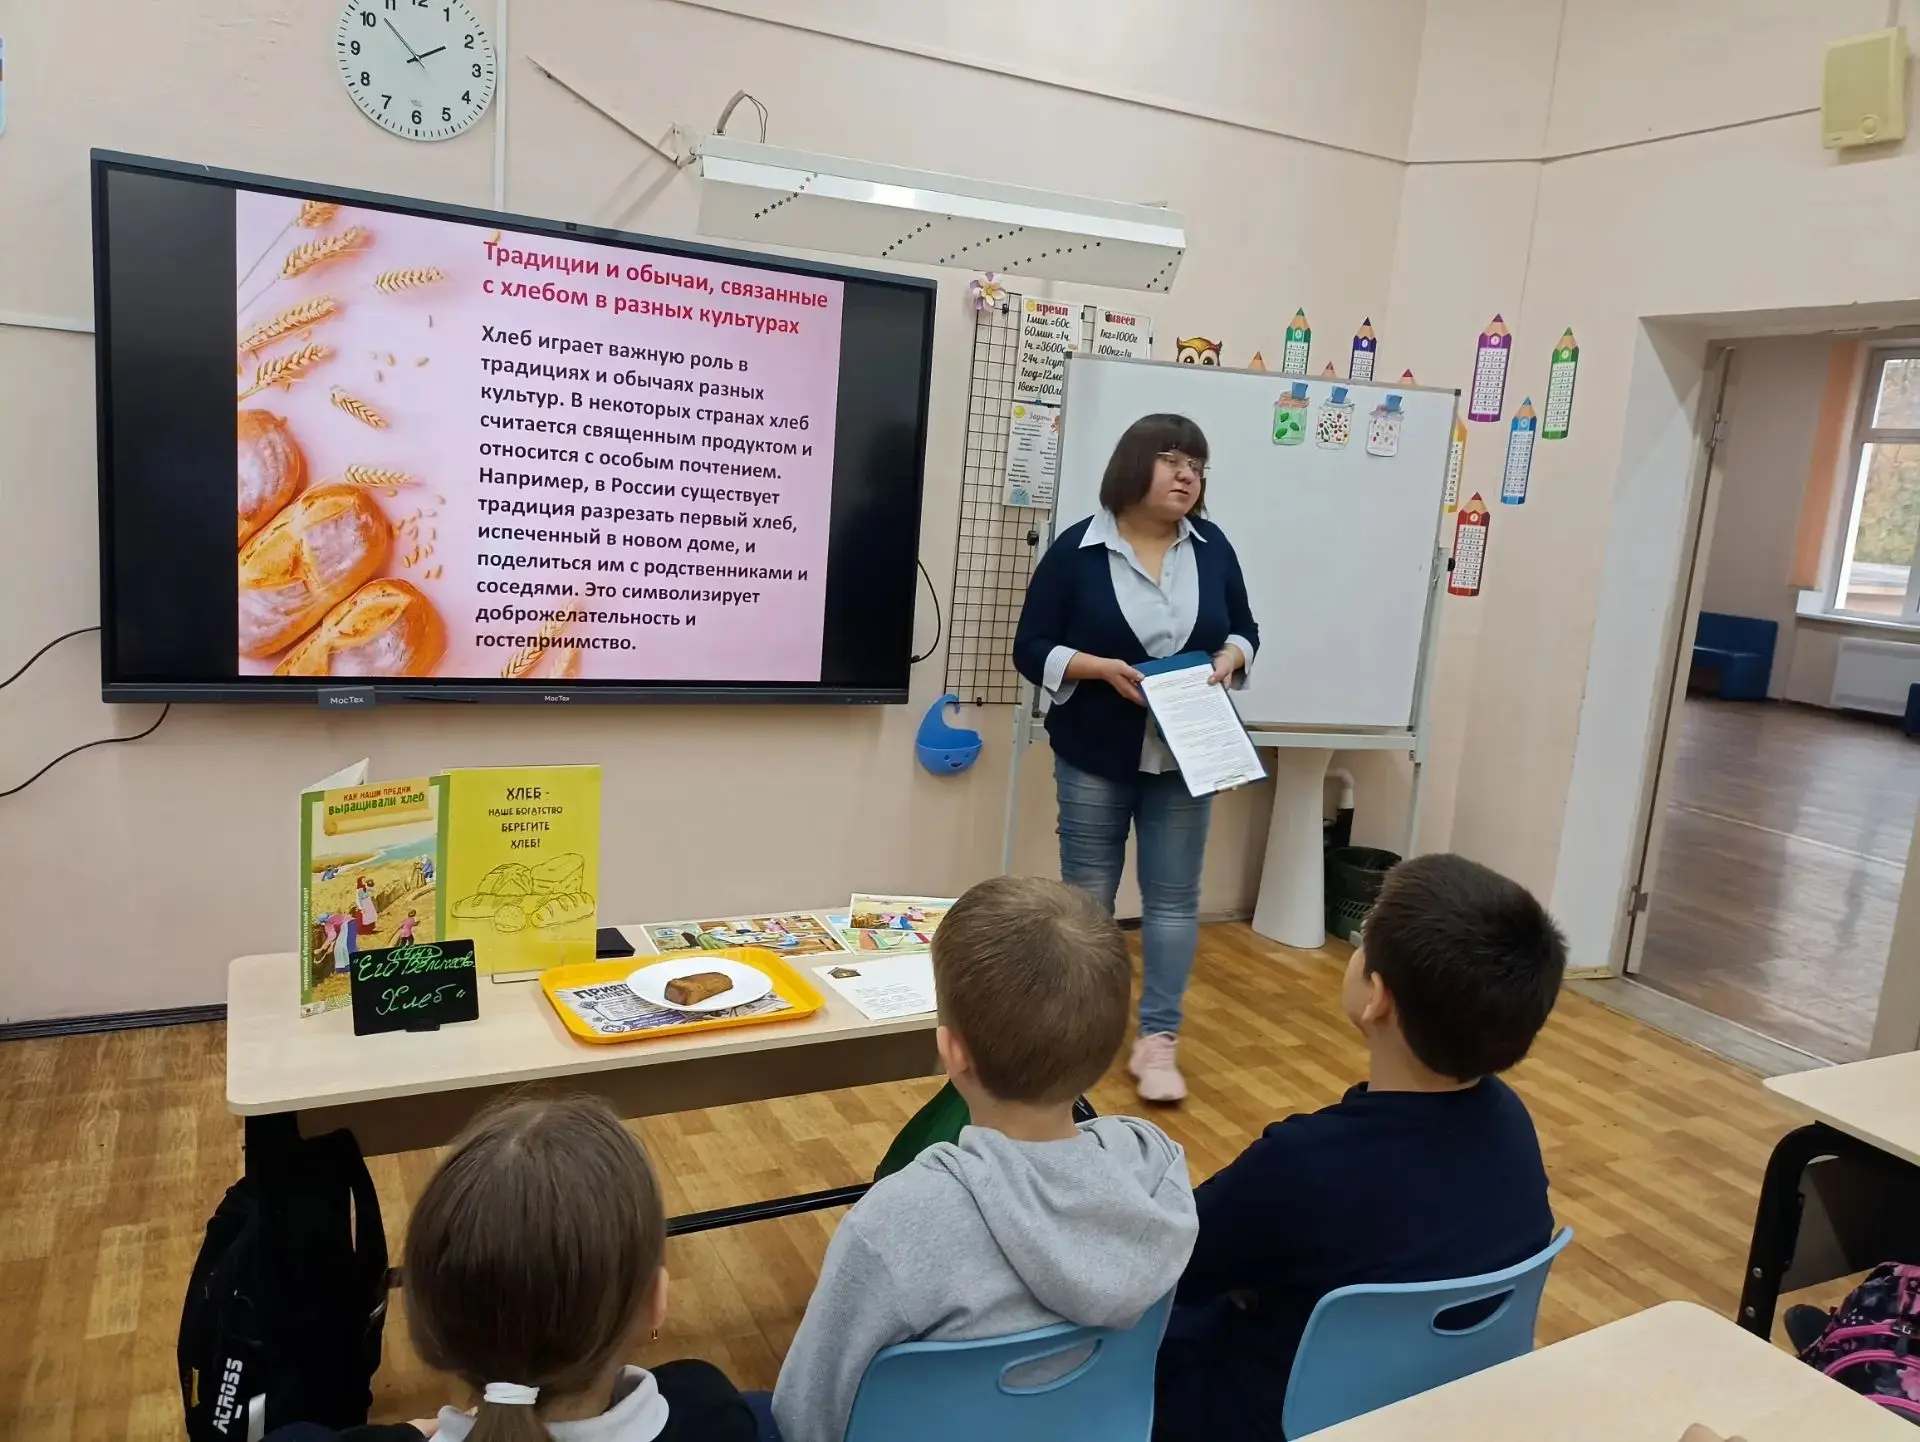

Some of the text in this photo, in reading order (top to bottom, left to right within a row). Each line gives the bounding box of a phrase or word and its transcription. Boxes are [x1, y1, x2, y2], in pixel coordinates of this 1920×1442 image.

[360, 11, 376, 27] 10
[443, 8, 449, 21] 1
[350, 41, 360, 55] 9
[464, 35, 474, 49] 2
[361, 72, 370, 86] 8
[472, 64, 481, 78] 3
[381, 94, 392, 109] 7
[461, 90, 471, 104] 4
[412, 110, 422, 124] 6
[442, 108, 450, 121] 5
[483, 241, 828, 308] Традиции и обычаи, связанные
[483, 280, 799, 334] с хлебом в разных культурах
[1036, 304, 1068, 316] время
[482, 326, 748, 373] Хлеб играет важную роль в
[481, 357, 764, 401] традициях и обычаях разных
[481, 385, 809, 430] культур. В некоторых странах хлеб
[480, 413, 812, 456] считается священным продуктом и
[480, 443, 781, 480] относится с особым почтением.
[479, 468, 779, 505] Например, в России существует
[478, 498, 798, 533] традиция разрезать первый хлеб,
[478, 524, 755, 555] испеченный в новом доме, и
[477, 552, 808, 581] поделиться им с родственниками и
[477, 578, 760, 605] соседями. Это символизирует
[476, 606, 696, 627] доброжелательность и
[476, 632, 637, 651] гостеприимство.
[344, 786, 411, 802] КАК НАШИ ПРЕДКИ
[507, 787, 541, 800] ХЛЕБ
[329, 792, 424, 815] выращивали хлеб
[489, 806, 562, 817] НАШЕ БОГАТСТВО
[502, 822, 549, 832] БЕРЕГИТЕ
[511, 839, 540, 849] ХЛЕБ!
[213, 1358, 243, 1434] ACROSS
